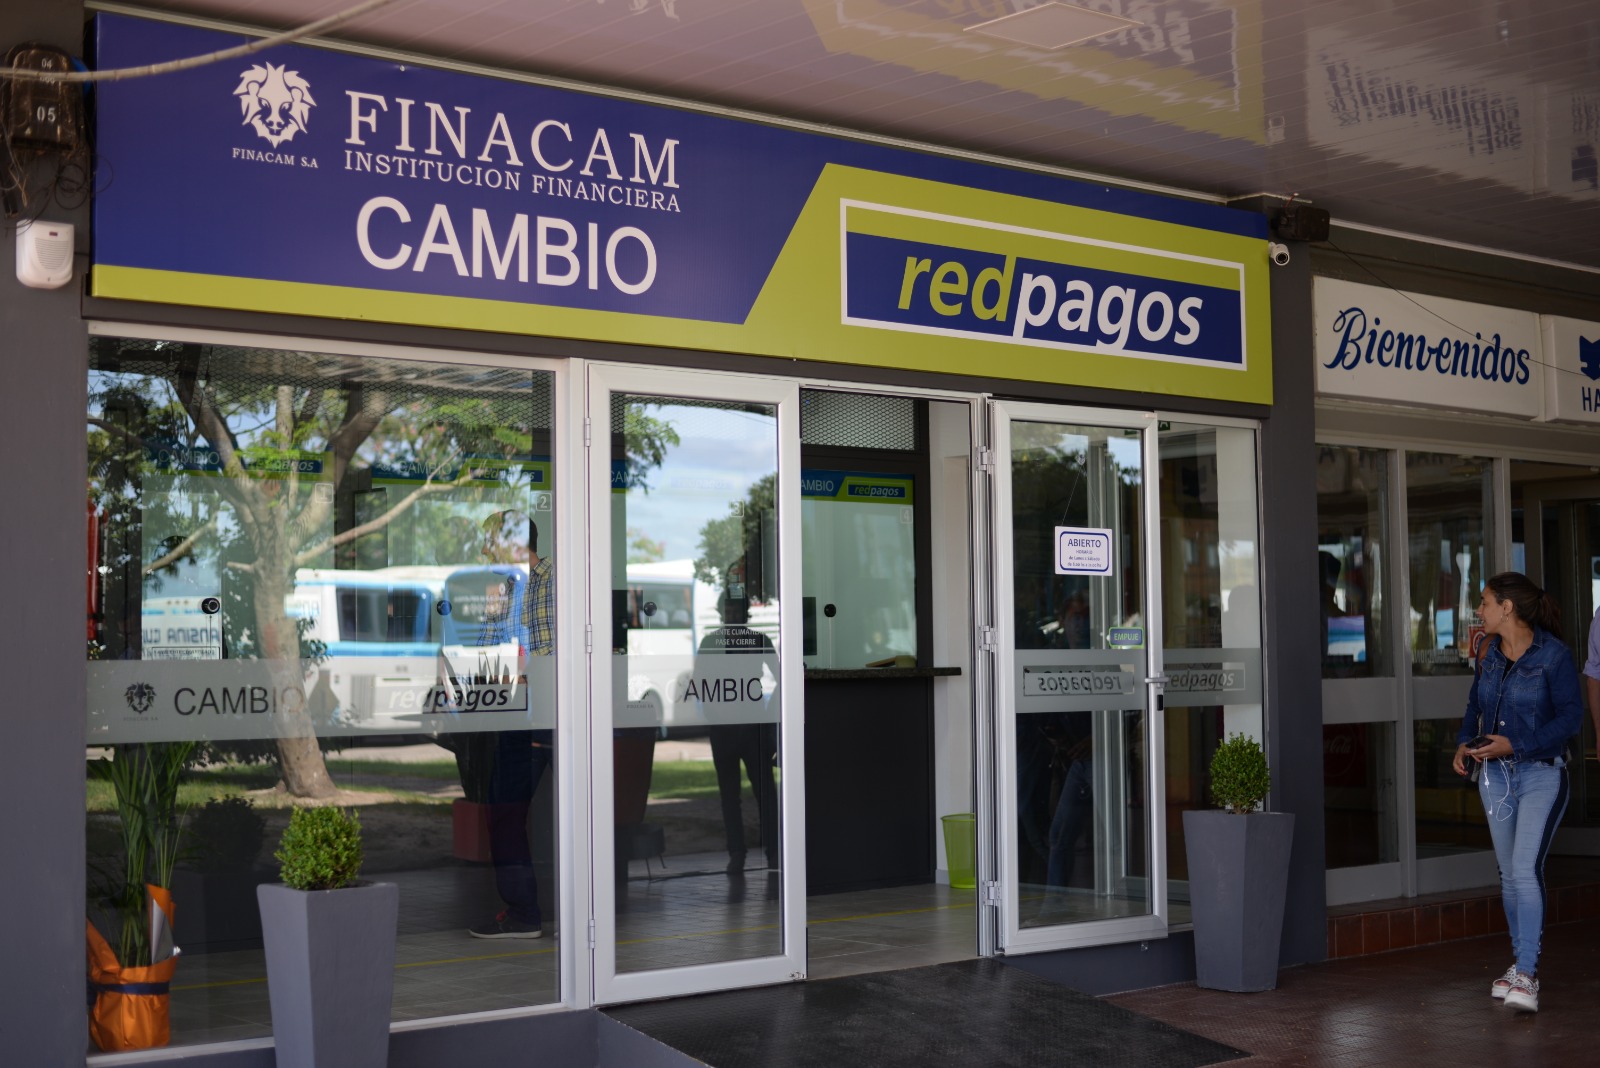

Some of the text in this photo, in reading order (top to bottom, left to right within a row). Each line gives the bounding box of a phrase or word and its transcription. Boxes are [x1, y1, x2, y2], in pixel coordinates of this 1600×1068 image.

[41, 58, 53, 69] 04
[36, 105, 56, 122] 05
[344, 90, 680, 189] FINACAM
[232, 147, 319, 169] FINACAM S.A
[344, 149, 681, 213] INSTITUCION FINANCIERA
[356, 196, 658, 295] CAMBIO
[897, 254, 1204, 351] redpagos
[1323, 307, 1530, 385] Bienvenidos
[399, 461, 451, 475] CAMBIO
[801, 480, 900, 497] AMBIO redpagos
[540, 496, 548, 509] 2
[1067, 538, 1102, 548] ABIERTO
[715, 638, 756, 646] PASE Y CIERRE
[1113, 633, 1139, 641] EMPUJE
[1164, 670, 1235, 692] redpagos
[174, 686, 304, 716] CAMBIO
[389, 687, 509, 712] redpagos
